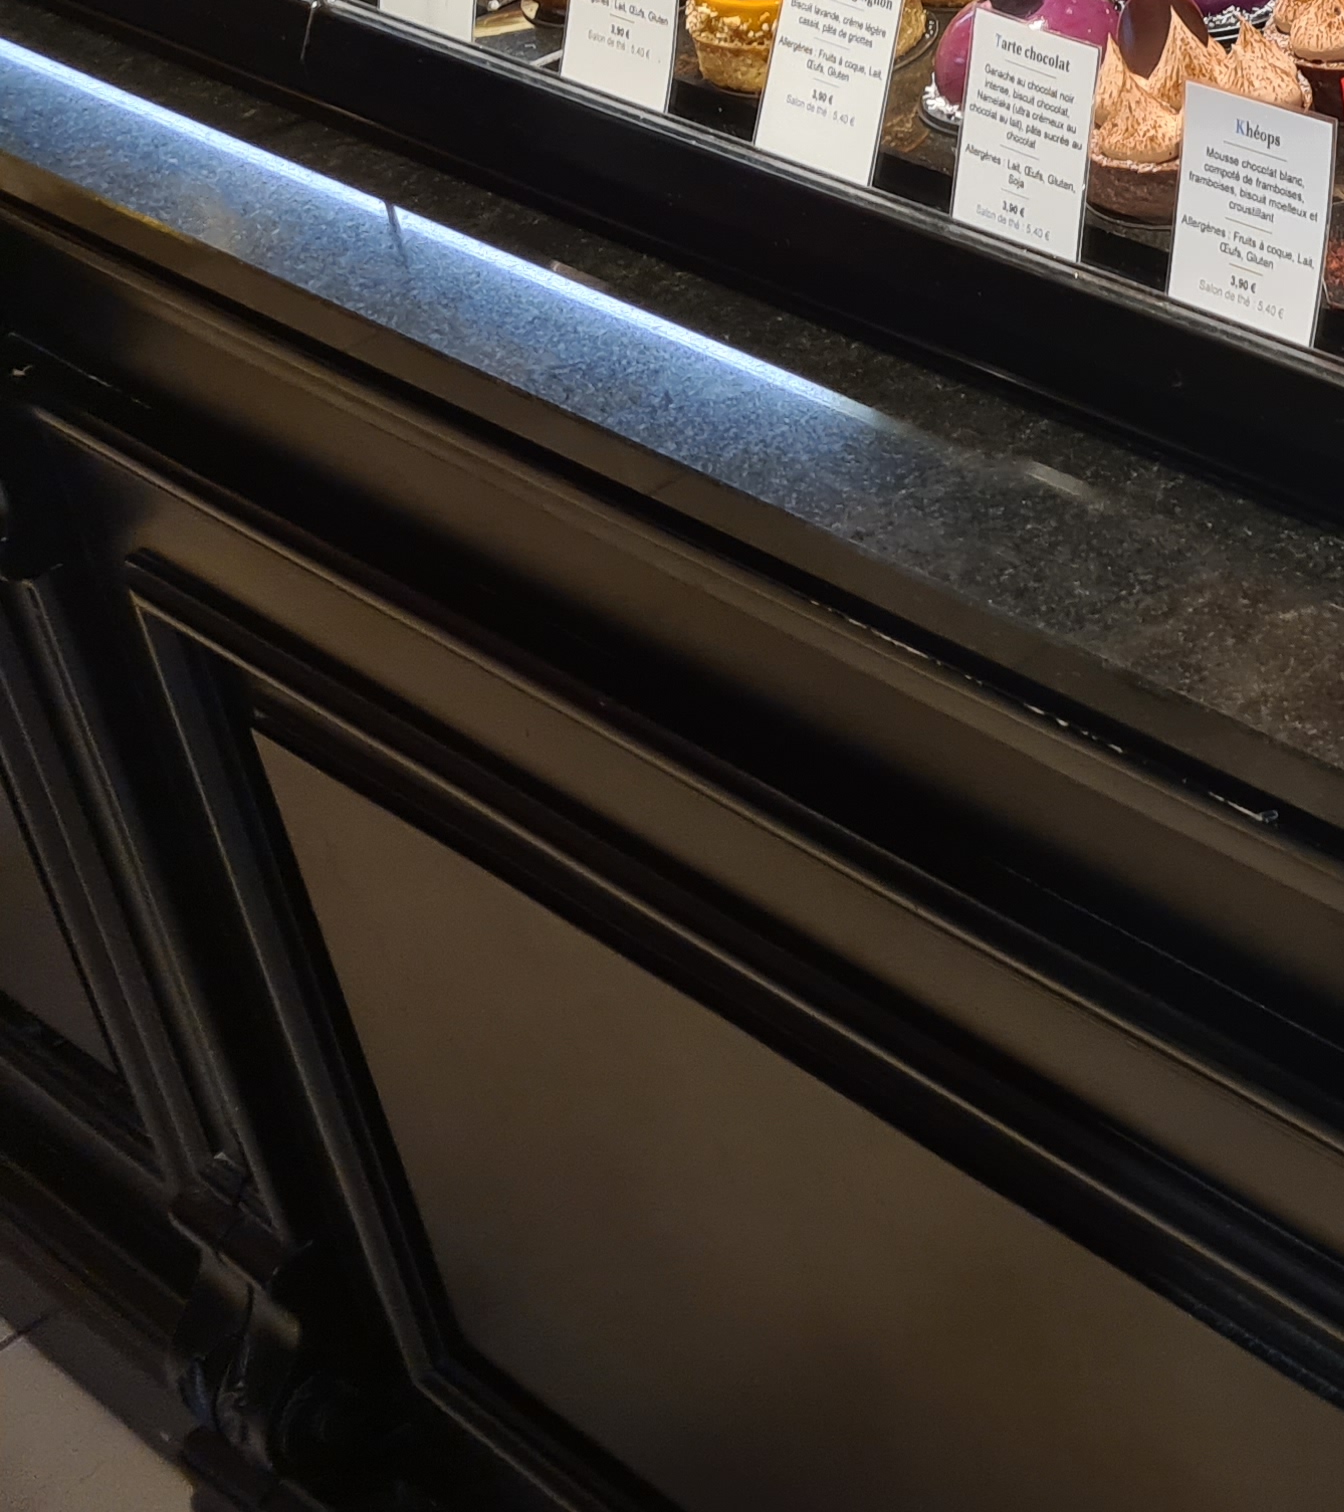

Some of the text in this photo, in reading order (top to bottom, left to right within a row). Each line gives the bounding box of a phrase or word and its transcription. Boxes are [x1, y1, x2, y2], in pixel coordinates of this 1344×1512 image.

[996, 33, 1070, 72] Tarte chocolat
[1236, 118, 1280, 149] Khéops
[1206, 146, 1239, 166] Mousse
[1241, 160, 1277, 178] chocolat
[1242, 174, 1253, 185] de
[1309, 212, 1317, 222] et
[1233, 230, 1256, 248] Fruits
[1198, 279, 1222, 296] Salon
[1224, 290, 1235, 301] de
